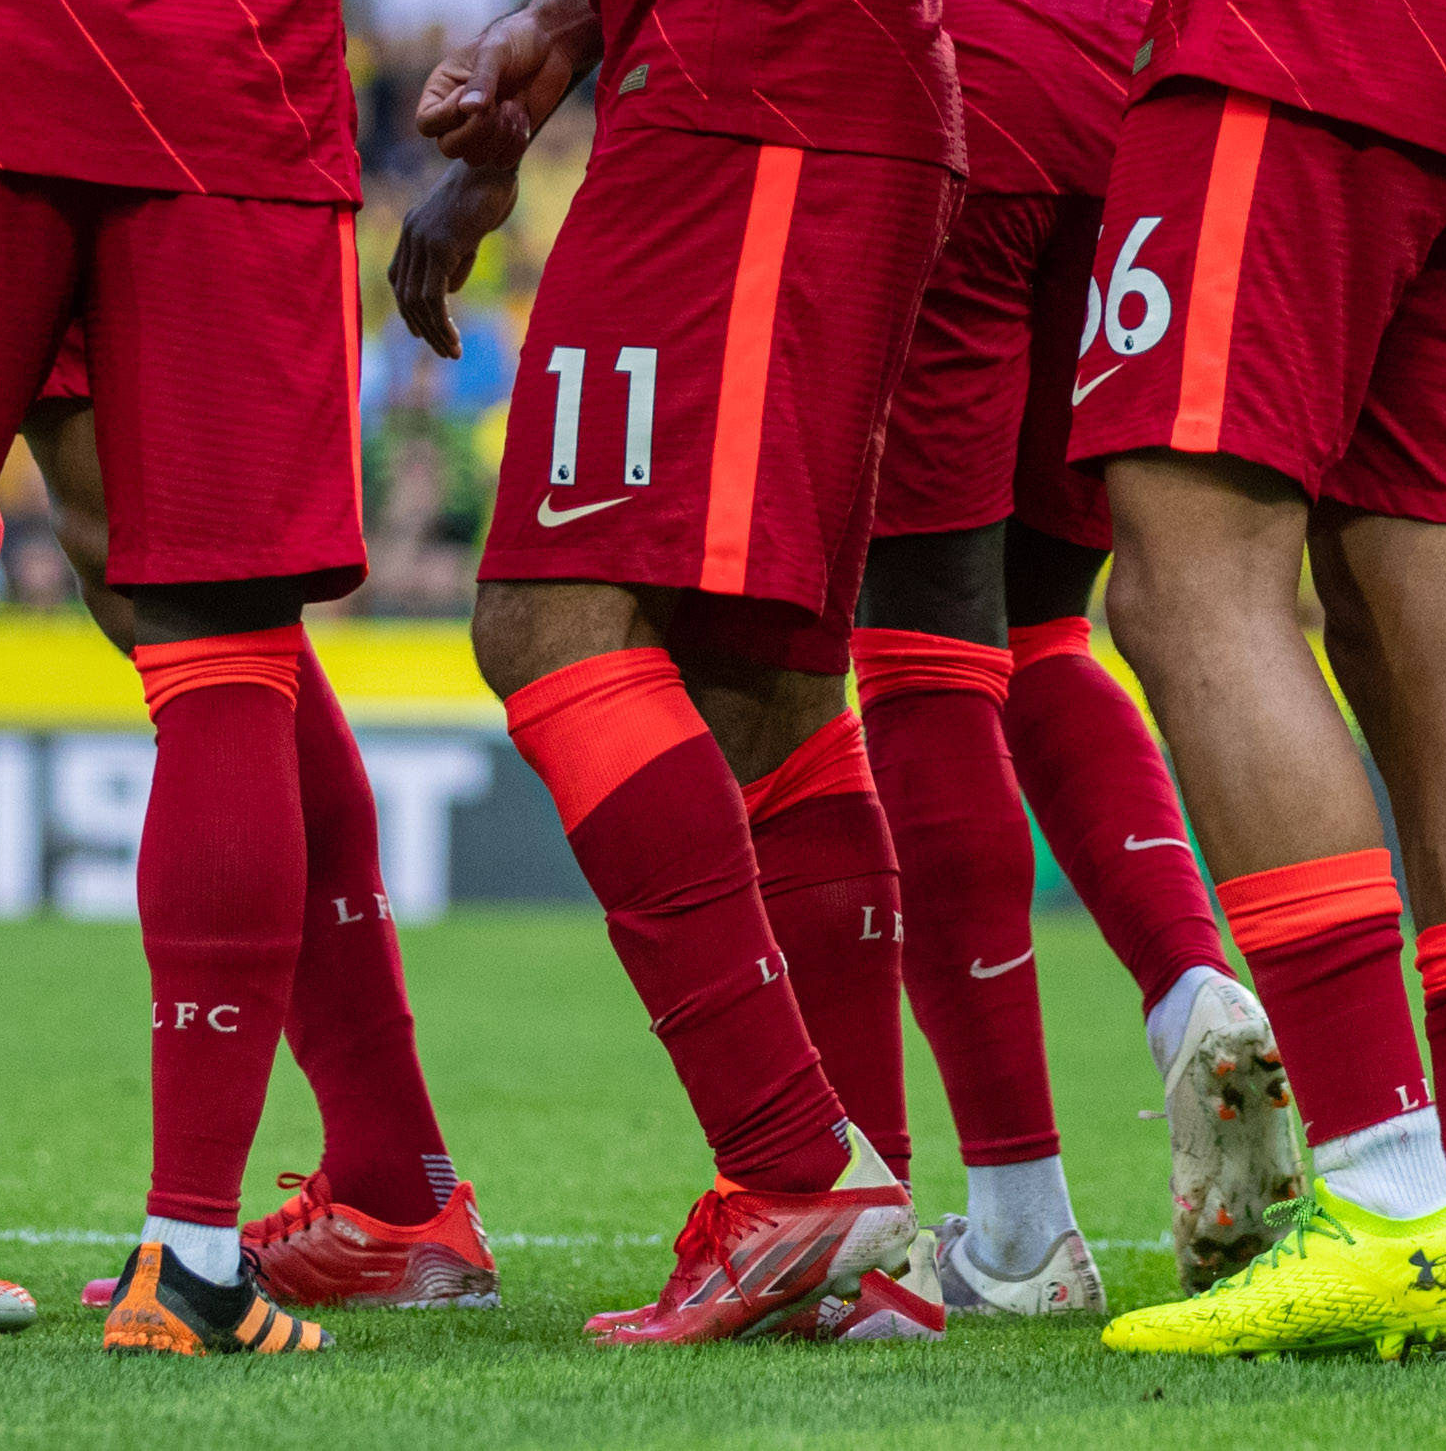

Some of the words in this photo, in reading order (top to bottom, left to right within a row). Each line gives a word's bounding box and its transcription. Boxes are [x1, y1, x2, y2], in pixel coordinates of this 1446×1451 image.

[1077, 216, 1172, 357] 6
[546, 345, 659, 486] 11
[151, 1000, 241, 1034] LFC
